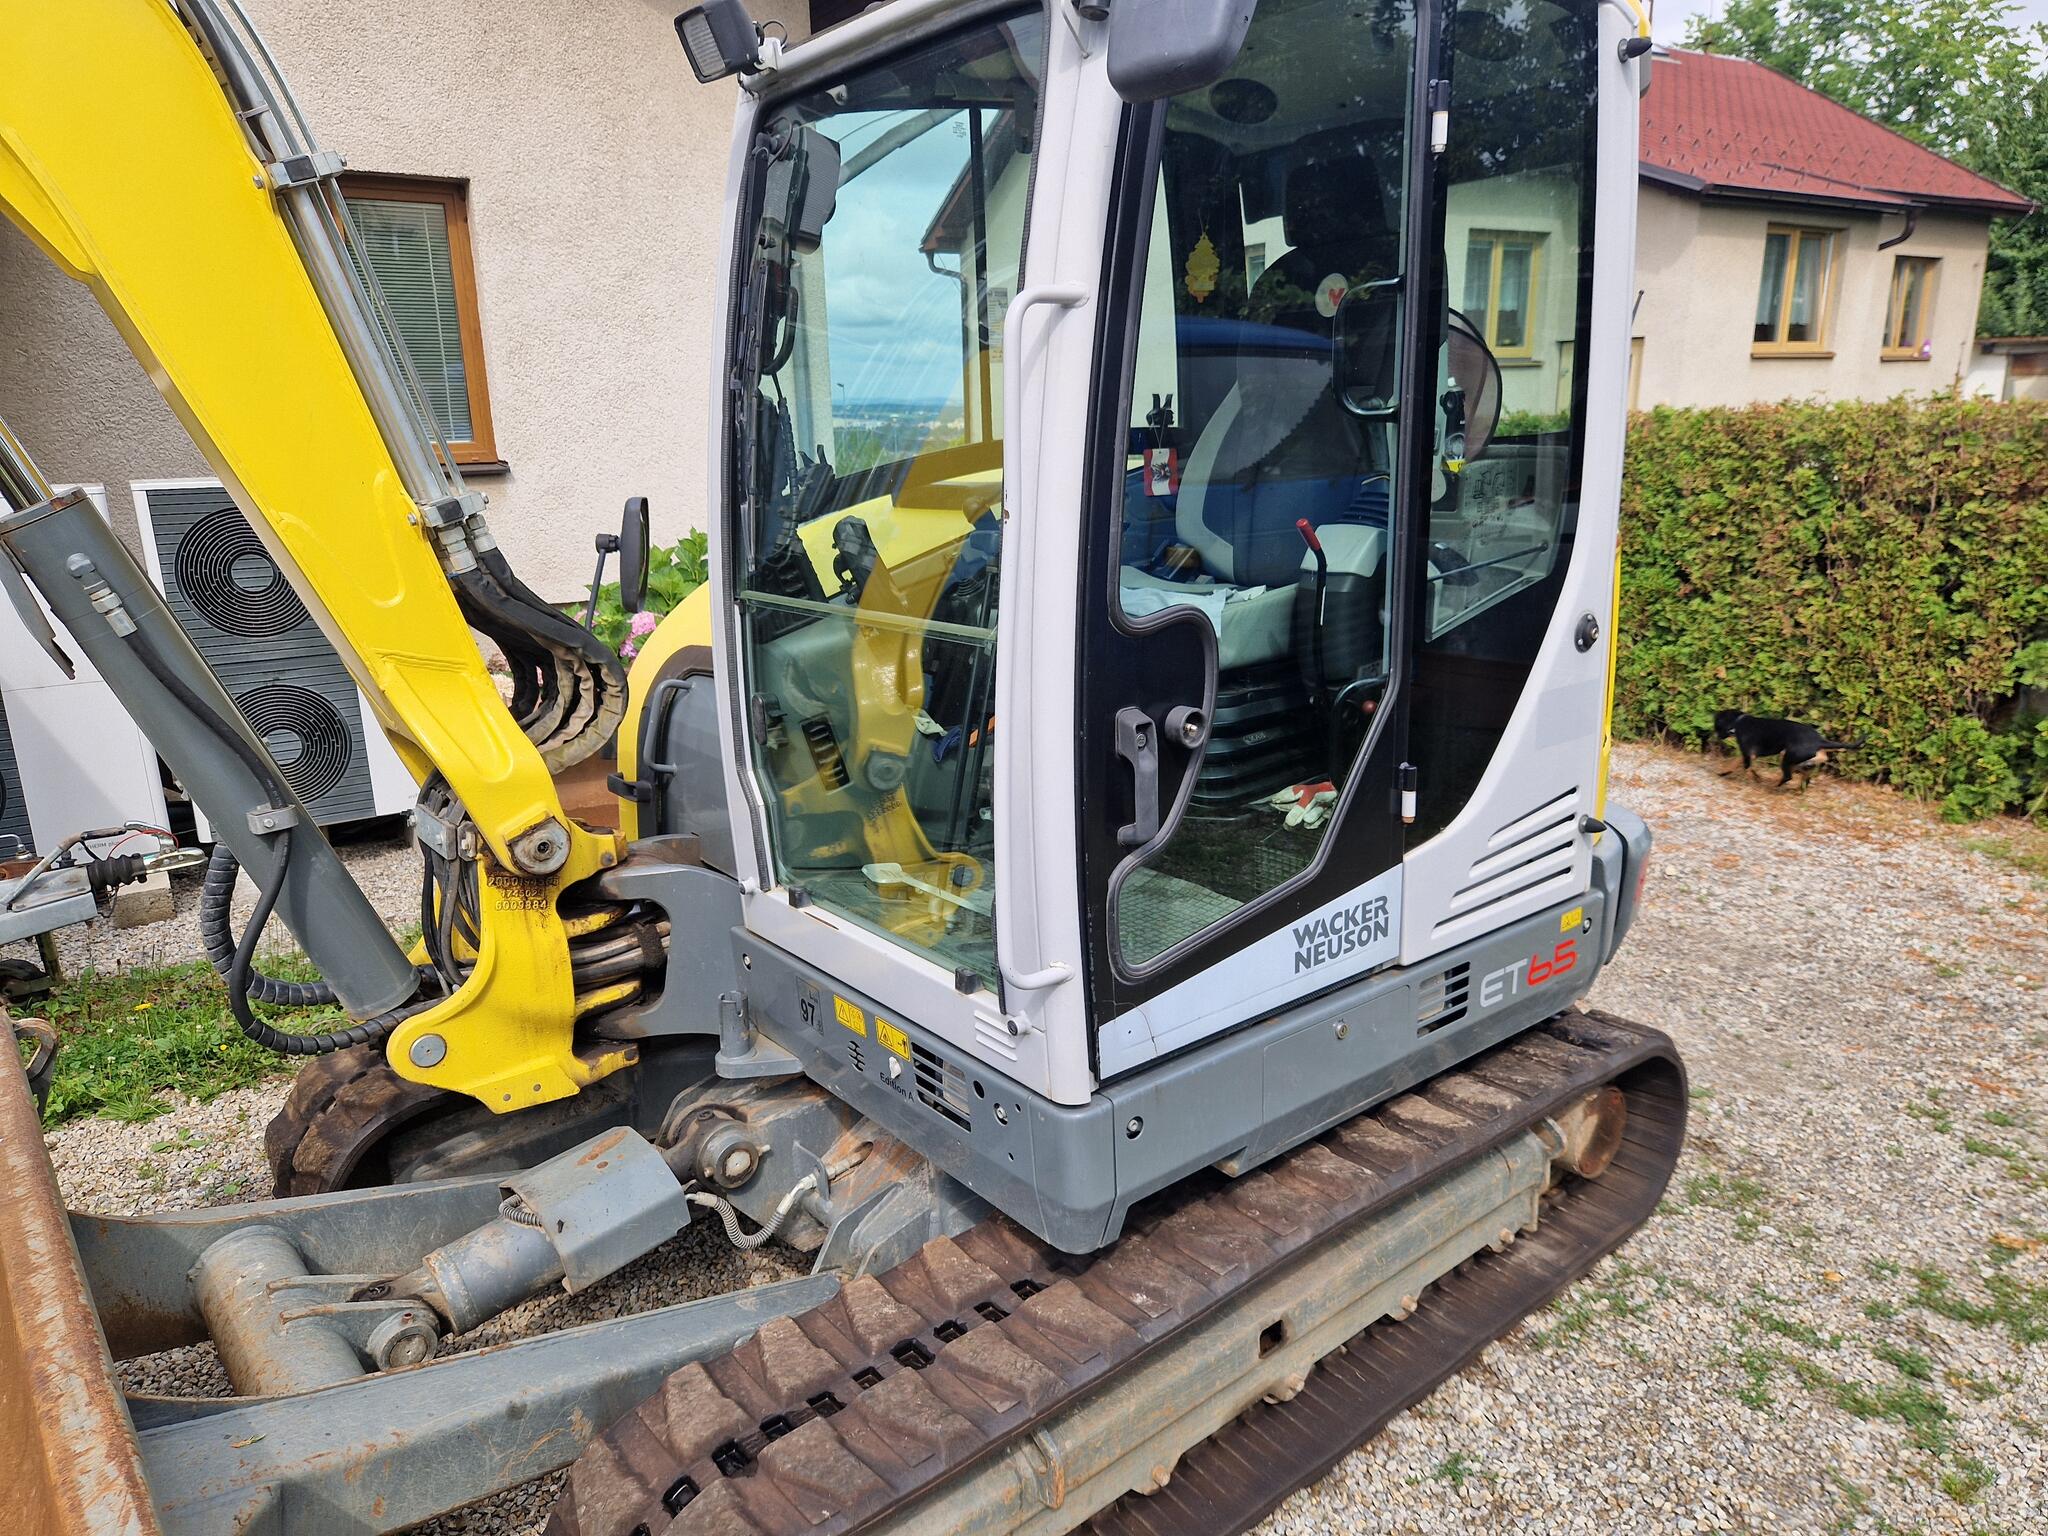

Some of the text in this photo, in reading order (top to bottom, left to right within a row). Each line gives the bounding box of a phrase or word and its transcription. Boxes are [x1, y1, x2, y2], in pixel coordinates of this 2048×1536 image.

[1292, 895, 1389, 949] WACKER
[1294, 916, 1389, 974] NEUSON
[1480, 939, 1578, 1008] ET65
[800, 998, 815, 1026] 97
[880, 1071, 915, 1102] Edition A
